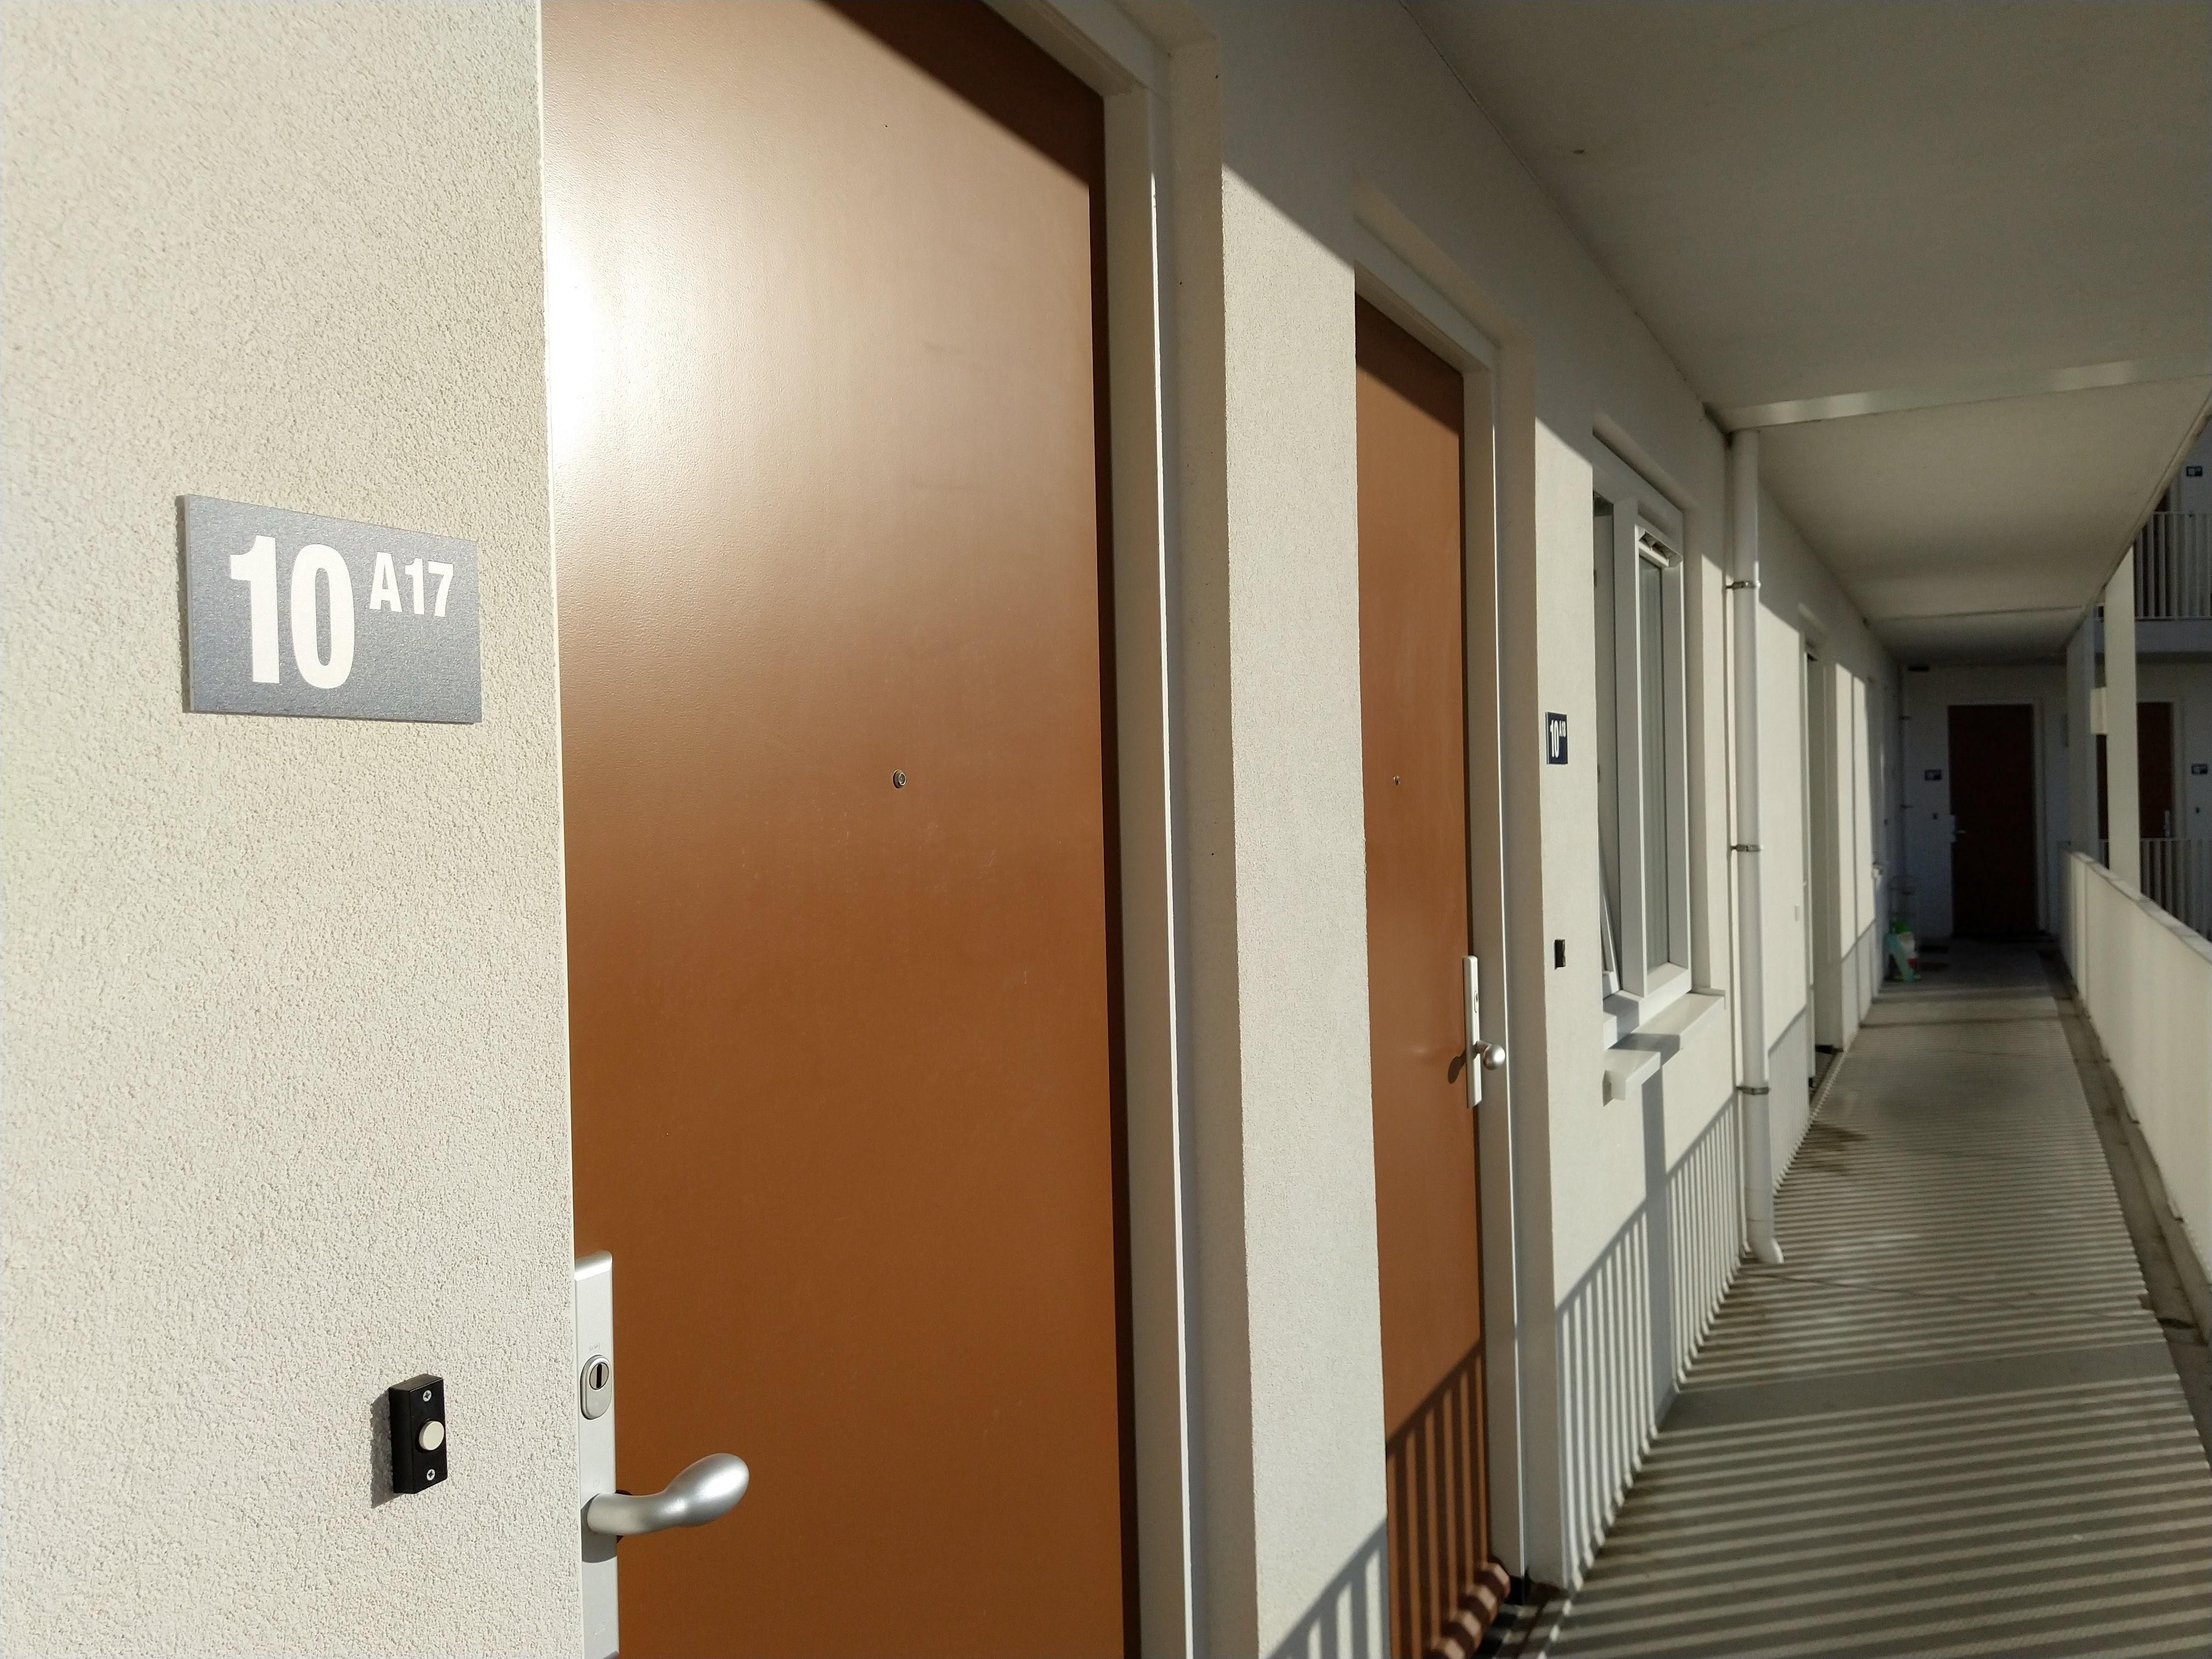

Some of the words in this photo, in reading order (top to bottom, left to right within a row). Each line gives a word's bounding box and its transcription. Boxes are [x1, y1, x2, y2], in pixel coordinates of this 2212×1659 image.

[230, 535, 355, 689] 10
[369, 551, 454, 617] A17
[1550, 719, 1559, 758] 10
